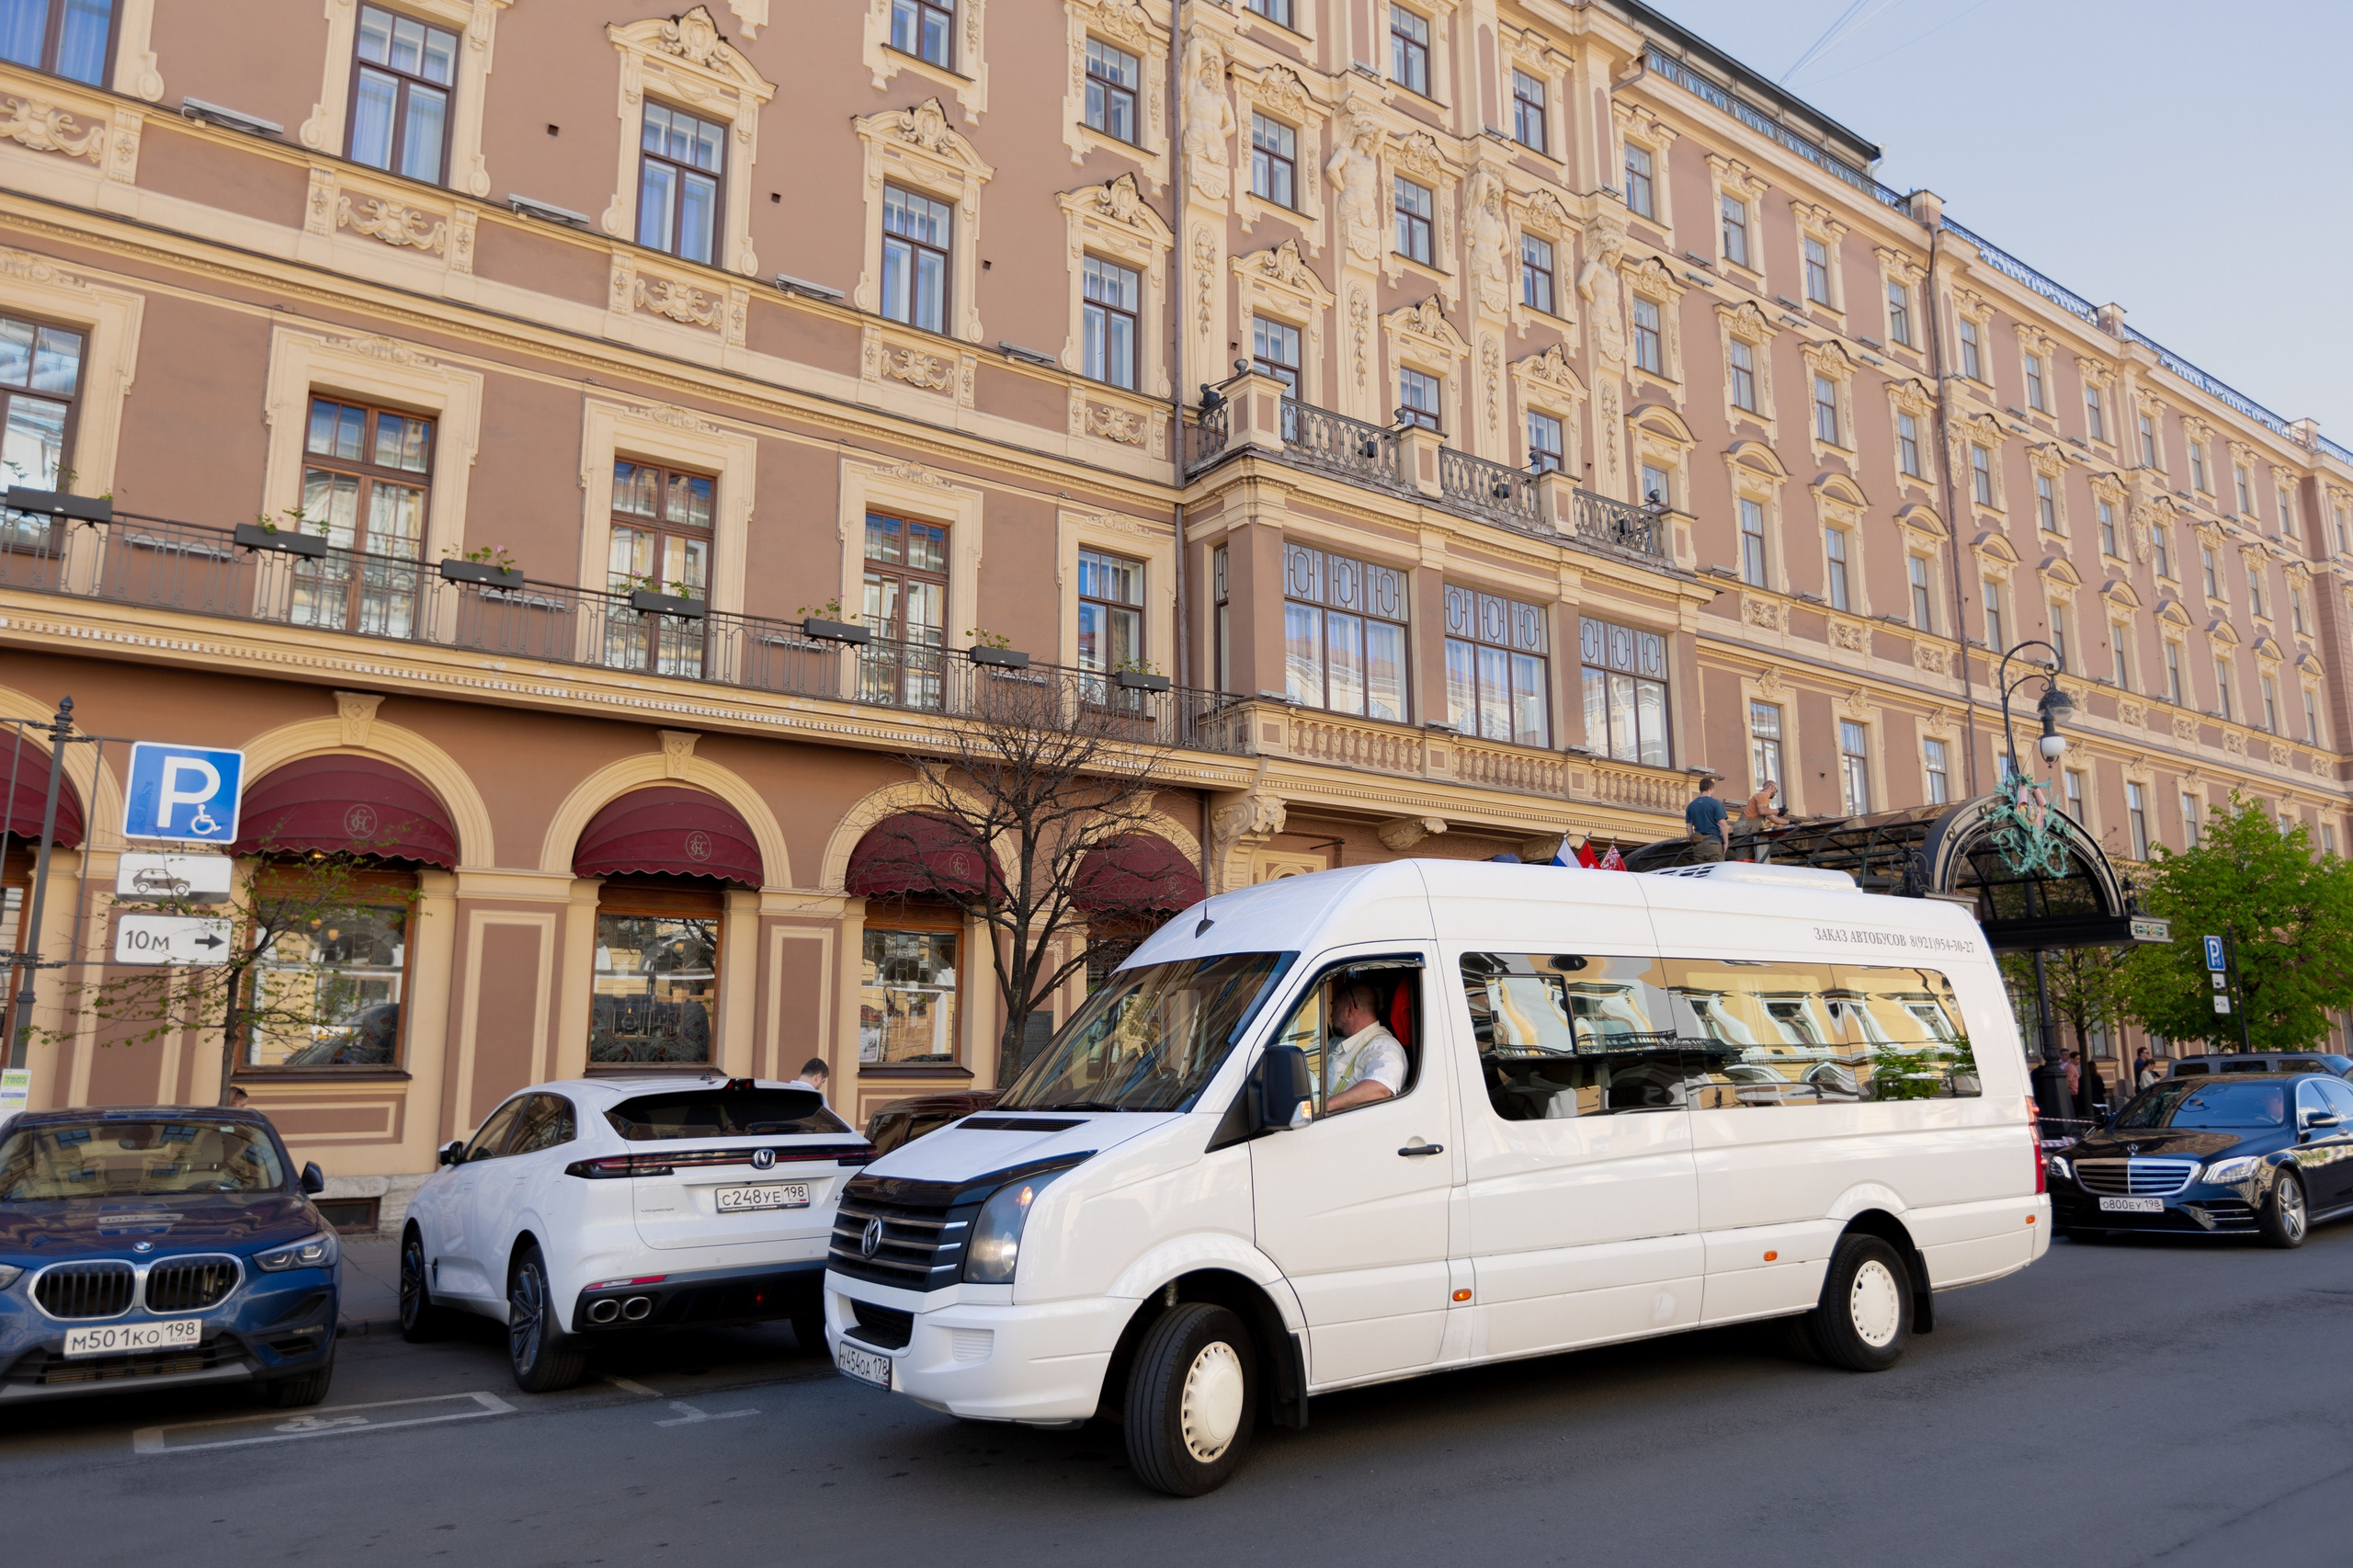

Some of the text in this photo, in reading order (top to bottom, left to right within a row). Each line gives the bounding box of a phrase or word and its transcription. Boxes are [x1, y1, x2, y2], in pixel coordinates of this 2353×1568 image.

[157, 756, 222, 829] P
[1813, 926, 1974, 954] ЗАКАЗ АВТОБУСОВ 8(921)954-30-27
[2209, 940, 2220, 967] P
[722, 1186, 804, 1206] С248УЕ 198
[2143, 1199, 2159, 1208] 198
[72, 1322, 196, 1351] М501КО 198
[873, 1357, 888, 1375] 178
